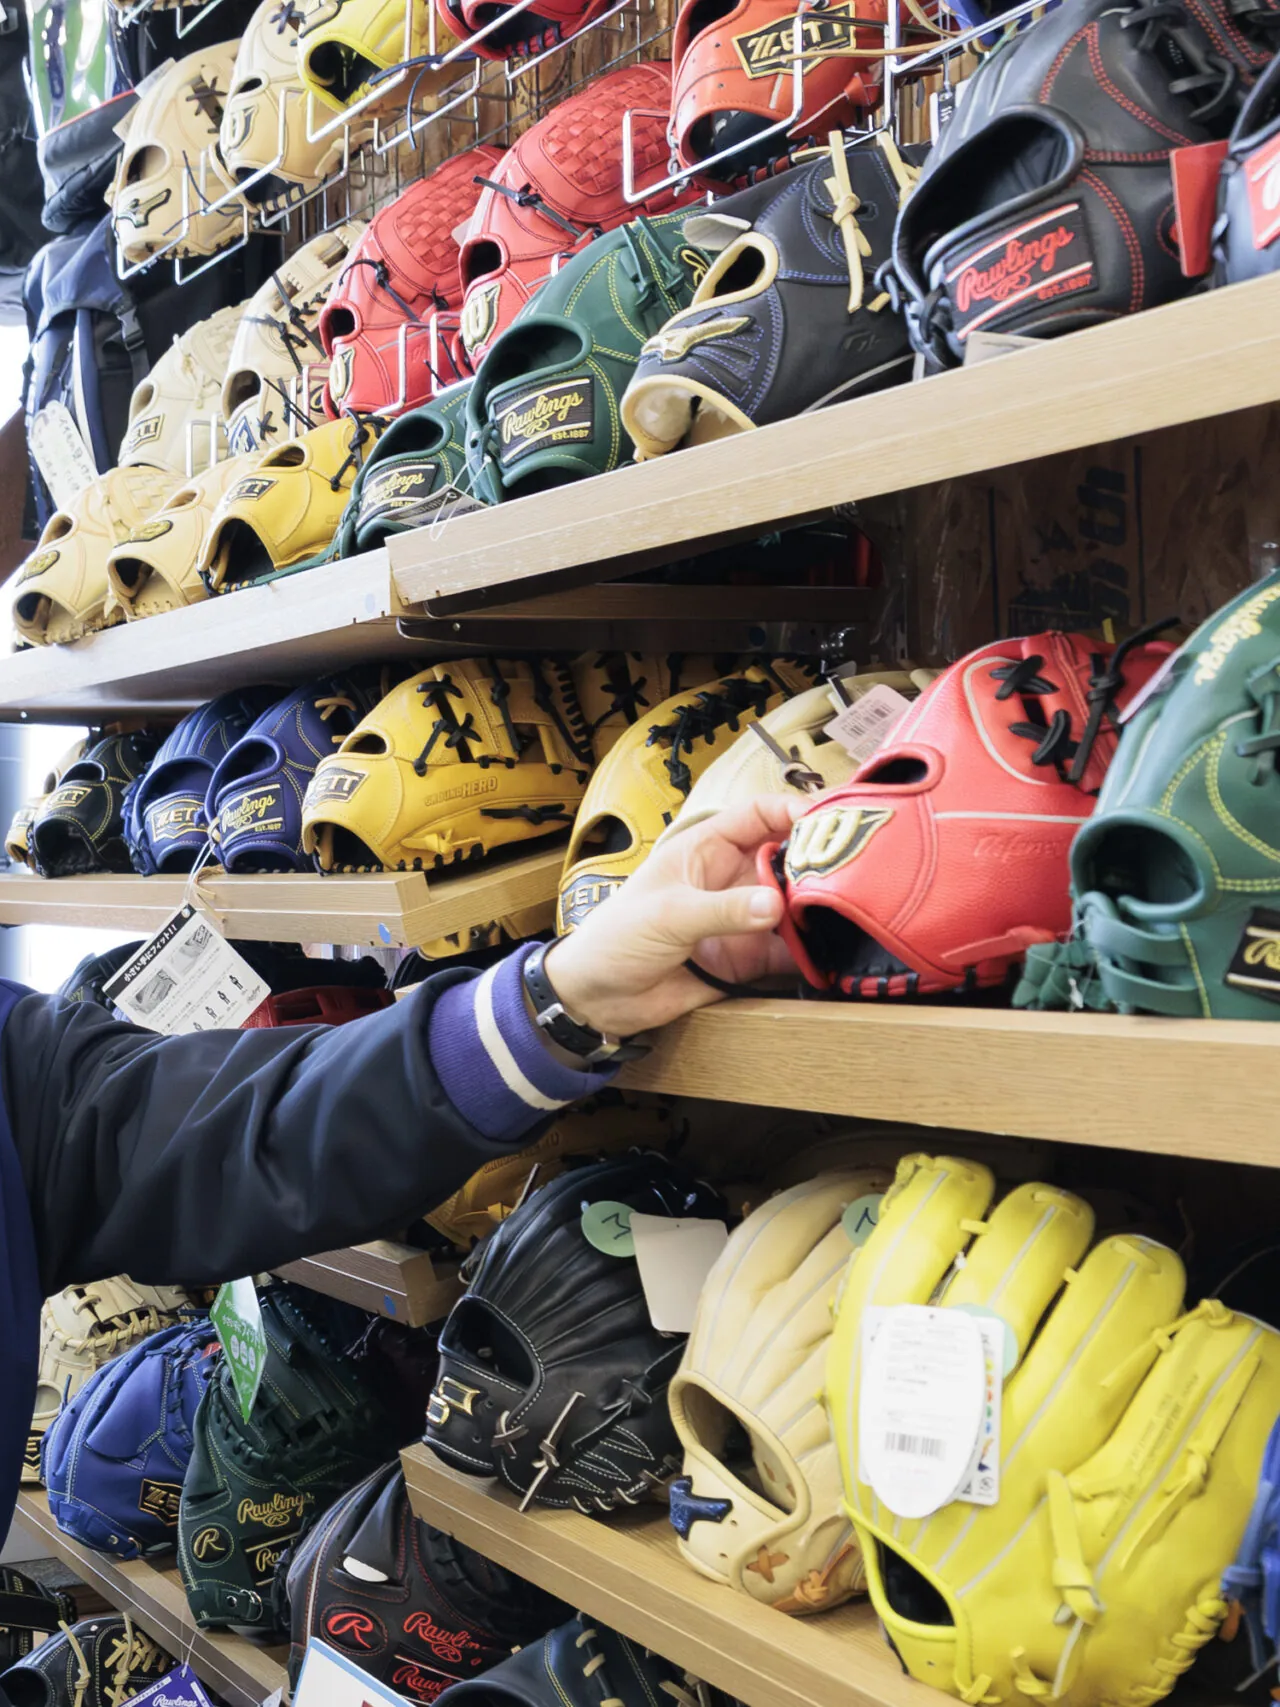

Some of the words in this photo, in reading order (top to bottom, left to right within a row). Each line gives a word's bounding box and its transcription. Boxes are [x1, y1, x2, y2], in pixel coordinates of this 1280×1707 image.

[956, 226, 1074, 312] Rawlings
[502, 392, 584, 444] Rawlings
[157, 807, 198, 827] ZET
[222, 795, 276, 833] Rawlings
[193, 1528, 226, 1559] R
[326, 1612, 374, 1649] R
